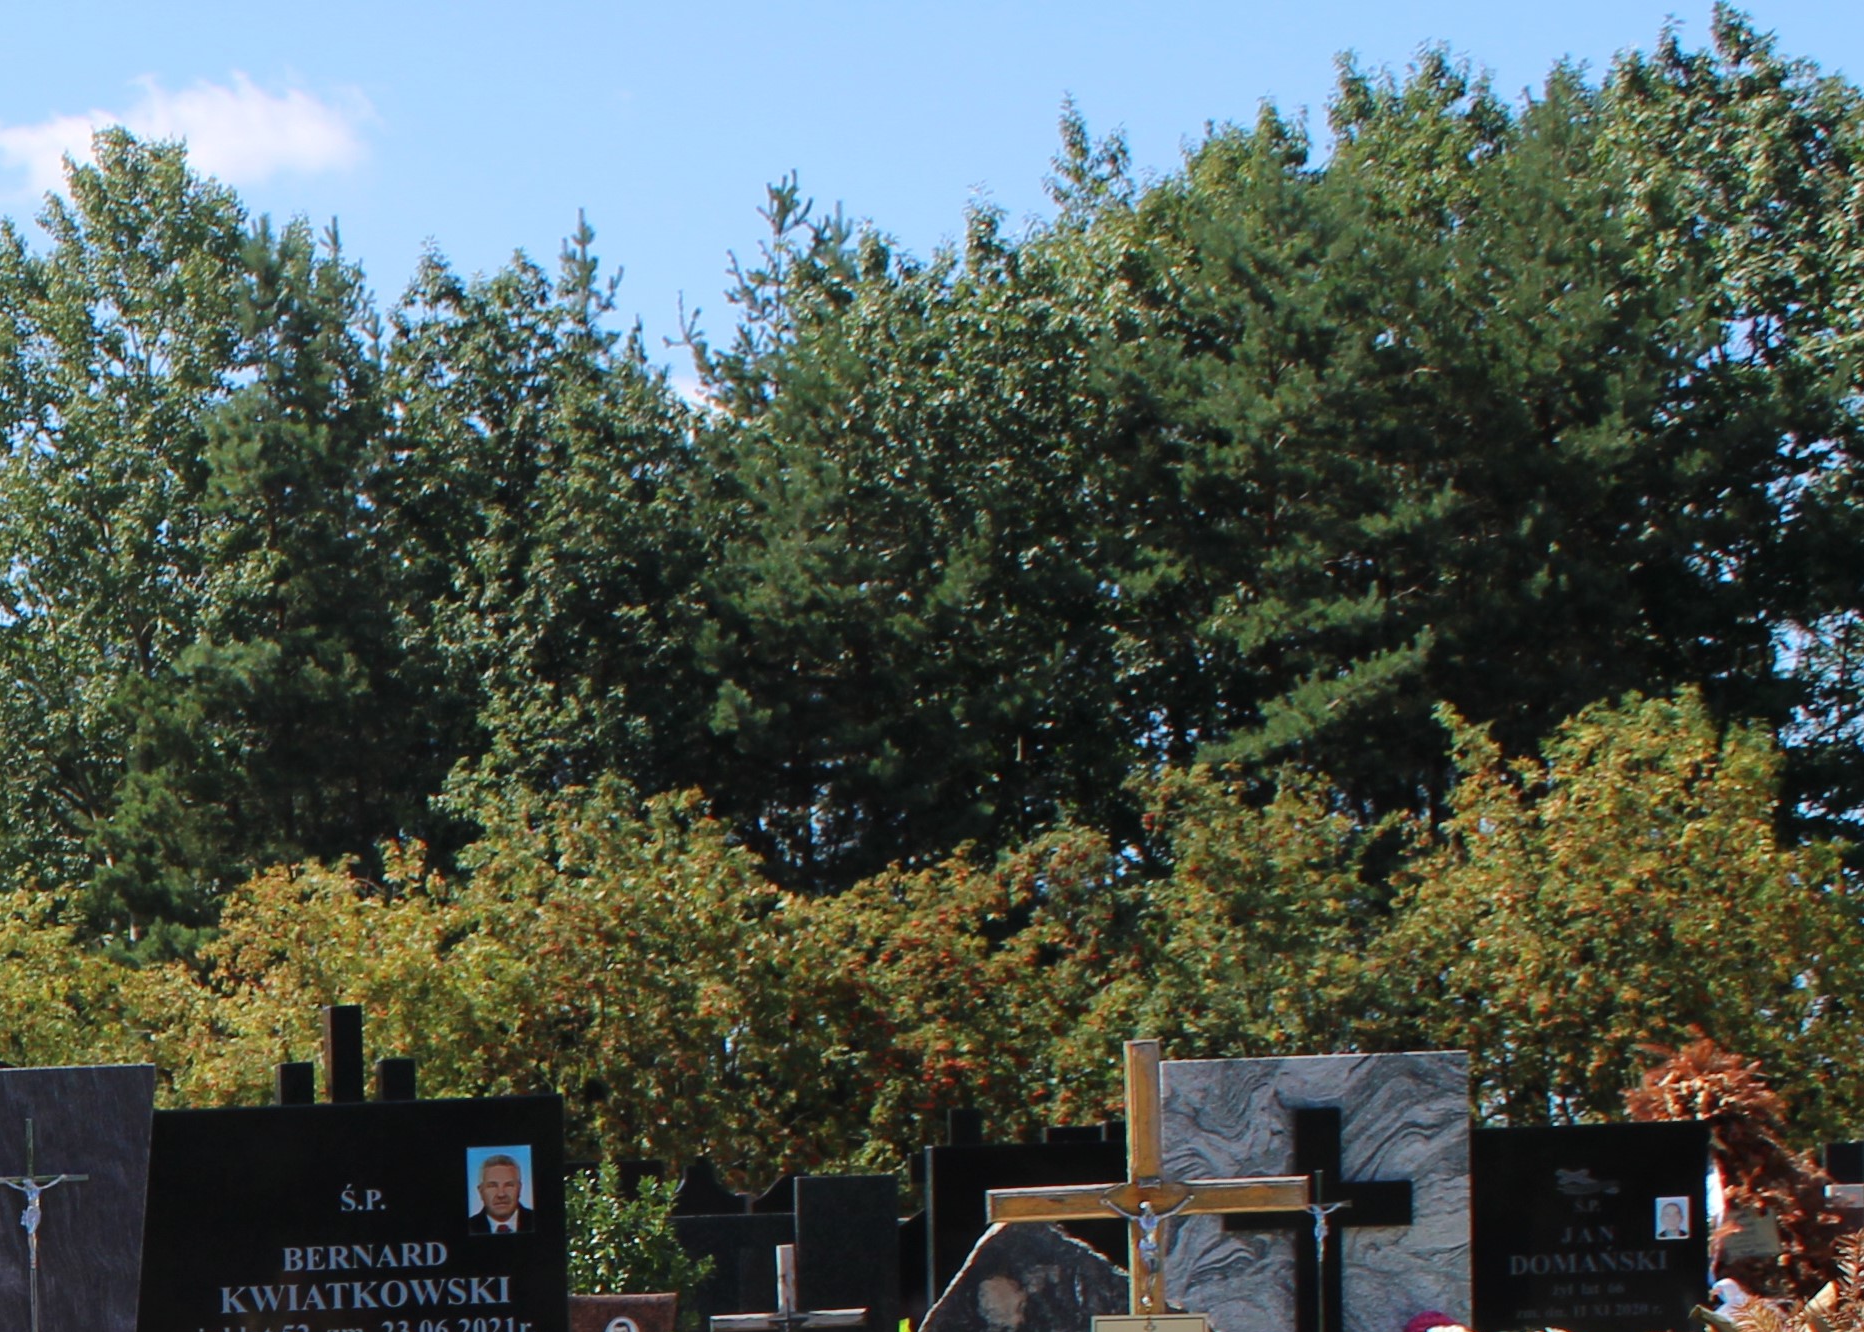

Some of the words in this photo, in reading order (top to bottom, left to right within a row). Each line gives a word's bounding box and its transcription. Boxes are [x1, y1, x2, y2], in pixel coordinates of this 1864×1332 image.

[340, 1184, 387, 1212] Ś.P.
[1561, 1226, 1614, 1244] JAN
[283, 1242, 448, 1272] BERNARD
[1509, 1246, 1668, 1275] DOMAŃSKI
[221, 1276, 511, 1314] KWIATKOWSKI
